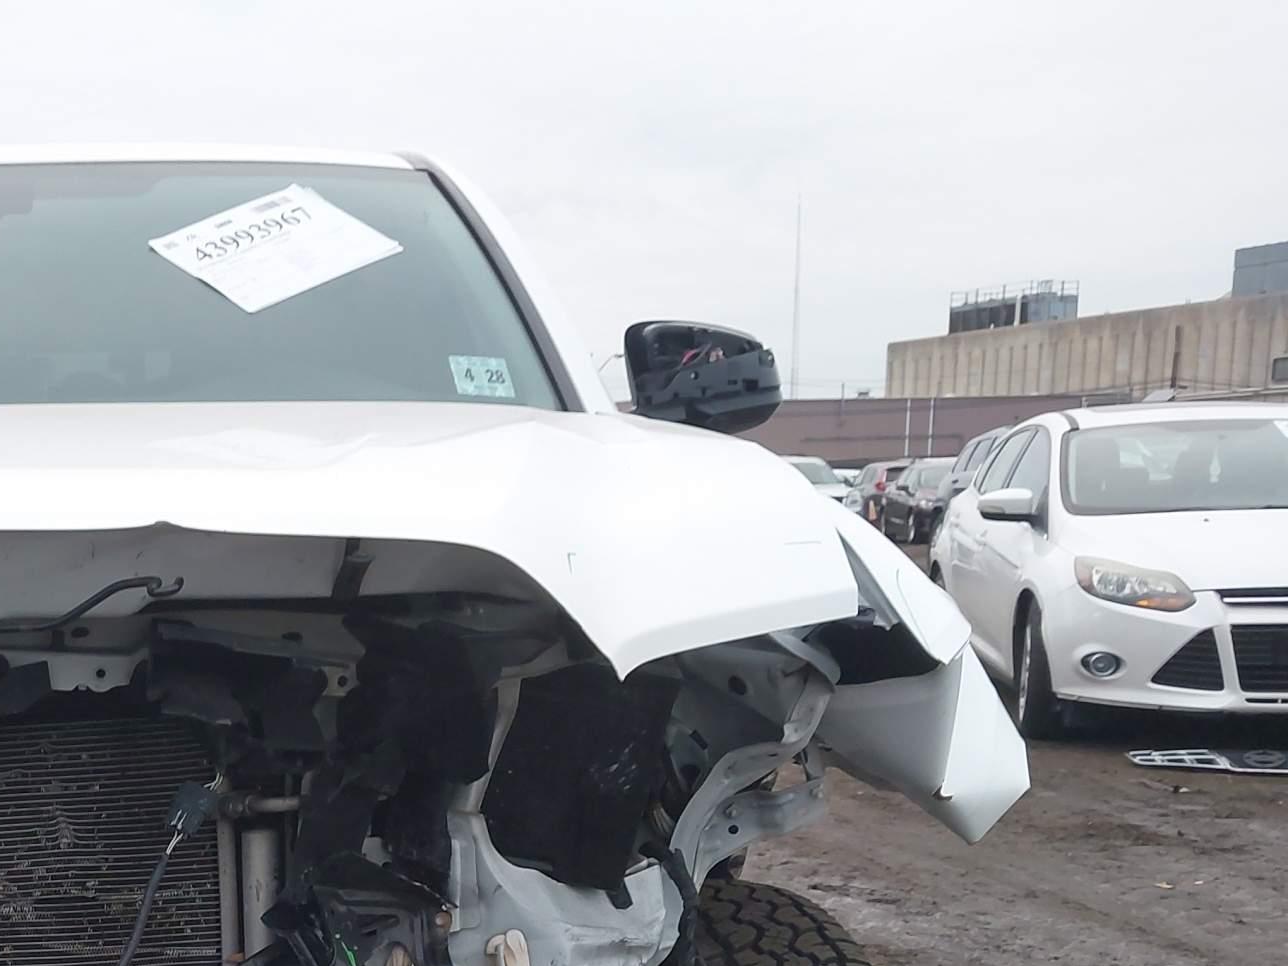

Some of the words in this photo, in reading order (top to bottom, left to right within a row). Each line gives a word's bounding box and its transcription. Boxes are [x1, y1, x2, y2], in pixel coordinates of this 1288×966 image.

[194, 205, 313, 263] 43993967
[464, 367, 476, 382] 4
[485, 368, 506, 384] 28
